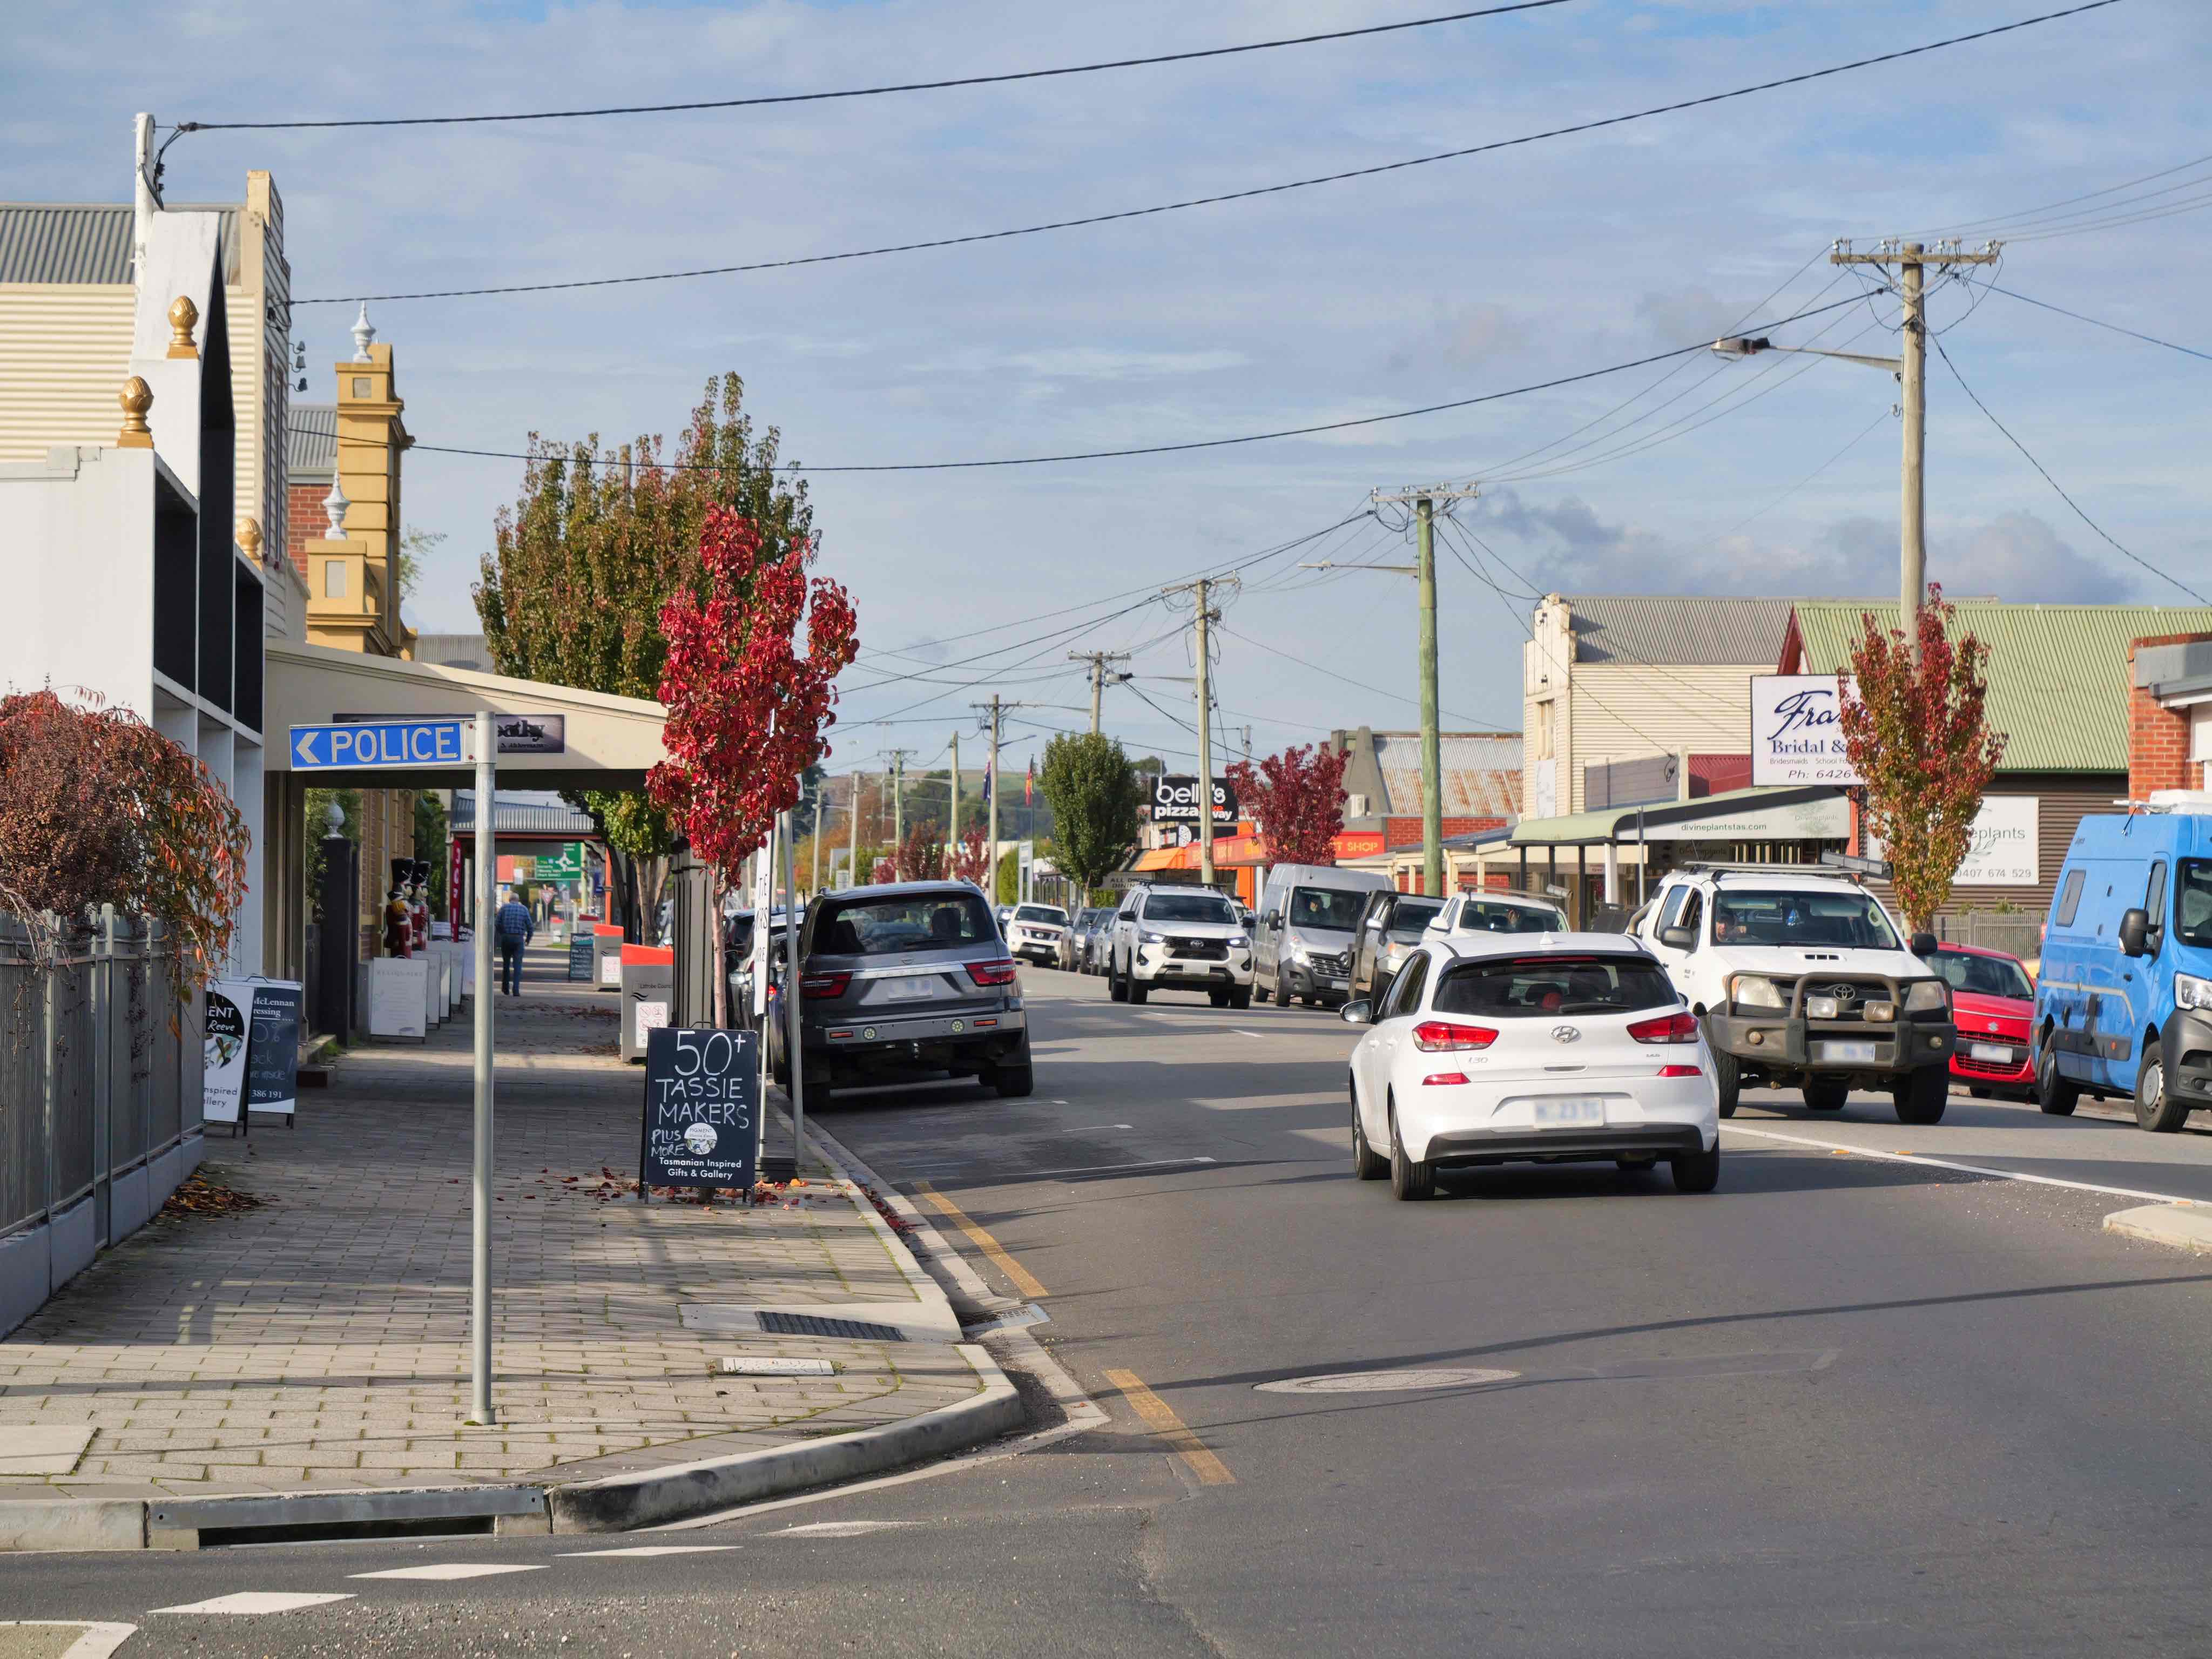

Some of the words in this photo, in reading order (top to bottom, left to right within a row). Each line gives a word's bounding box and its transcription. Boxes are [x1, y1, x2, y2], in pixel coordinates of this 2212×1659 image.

[1767, 691, 1842, 740] Fra
[331, 726, 457, 763] POLICE
[1772, 739, 1824, 754] Bridal
[1831, 739, 1846, 753] &
[1788, 770, 1809, 778] Ph:
[1816, 770, 1851, 778] 6426
[1156, 777, 1226, 804] bell's
[1155, 803, 1199, 819] pizza
[1347, 842, 1378, 852] SHOP
[1988, 869, 2006, 878] 674
[2012, 869, 2031, 878] 529
[253, 1008, 281, 1018] ressing
[207, 1020, 235, 1031] Reeve
[204, 1087, 238, 1096] nspired
[251, 1089, 267, 1097] 386
[269, 1090, 282, 1098] 191
[655, 1077, 743, 1103] TASSIE
[658, 1101, 749, 1129] MAKERS
[651, 1129, 682, 1144] PLUS
[651, 1143, 685, 1157] MORE
[659, 1157, 704, 1167] Tasmanian
[707, 1159, 741, 1169] Inspired
[668, 1168, 687, 1177] Gifts
[691, 1169, 697, 1177] &
[700, 1170, 733, 1181] Gallery
